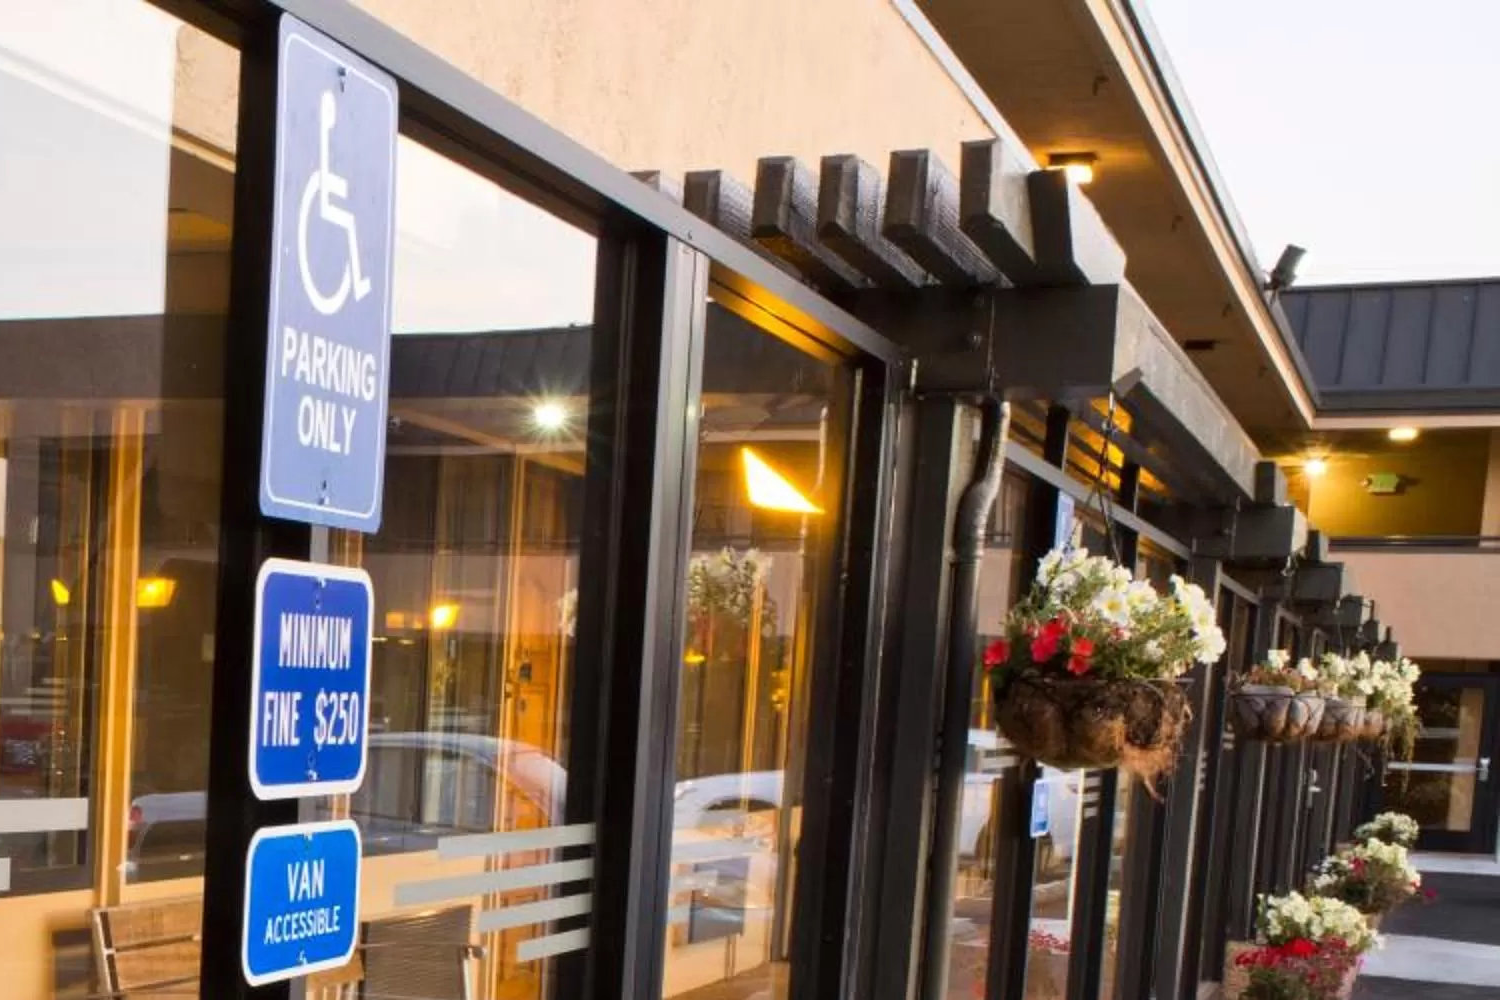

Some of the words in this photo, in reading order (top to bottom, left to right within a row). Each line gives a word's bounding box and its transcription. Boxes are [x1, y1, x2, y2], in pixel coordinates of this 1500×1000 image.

[281, 325, 376, 401] PARKING
[297, 395, 356, 455] ONLY
[278, 612, 352, 670] MINIMUM
[263, 692, 301, 747] FINE
[313, 688, 359, 752] $250
[287, 859, 324, 904] VAN
[263, 905, 341, 946] ACCESSIBLE
